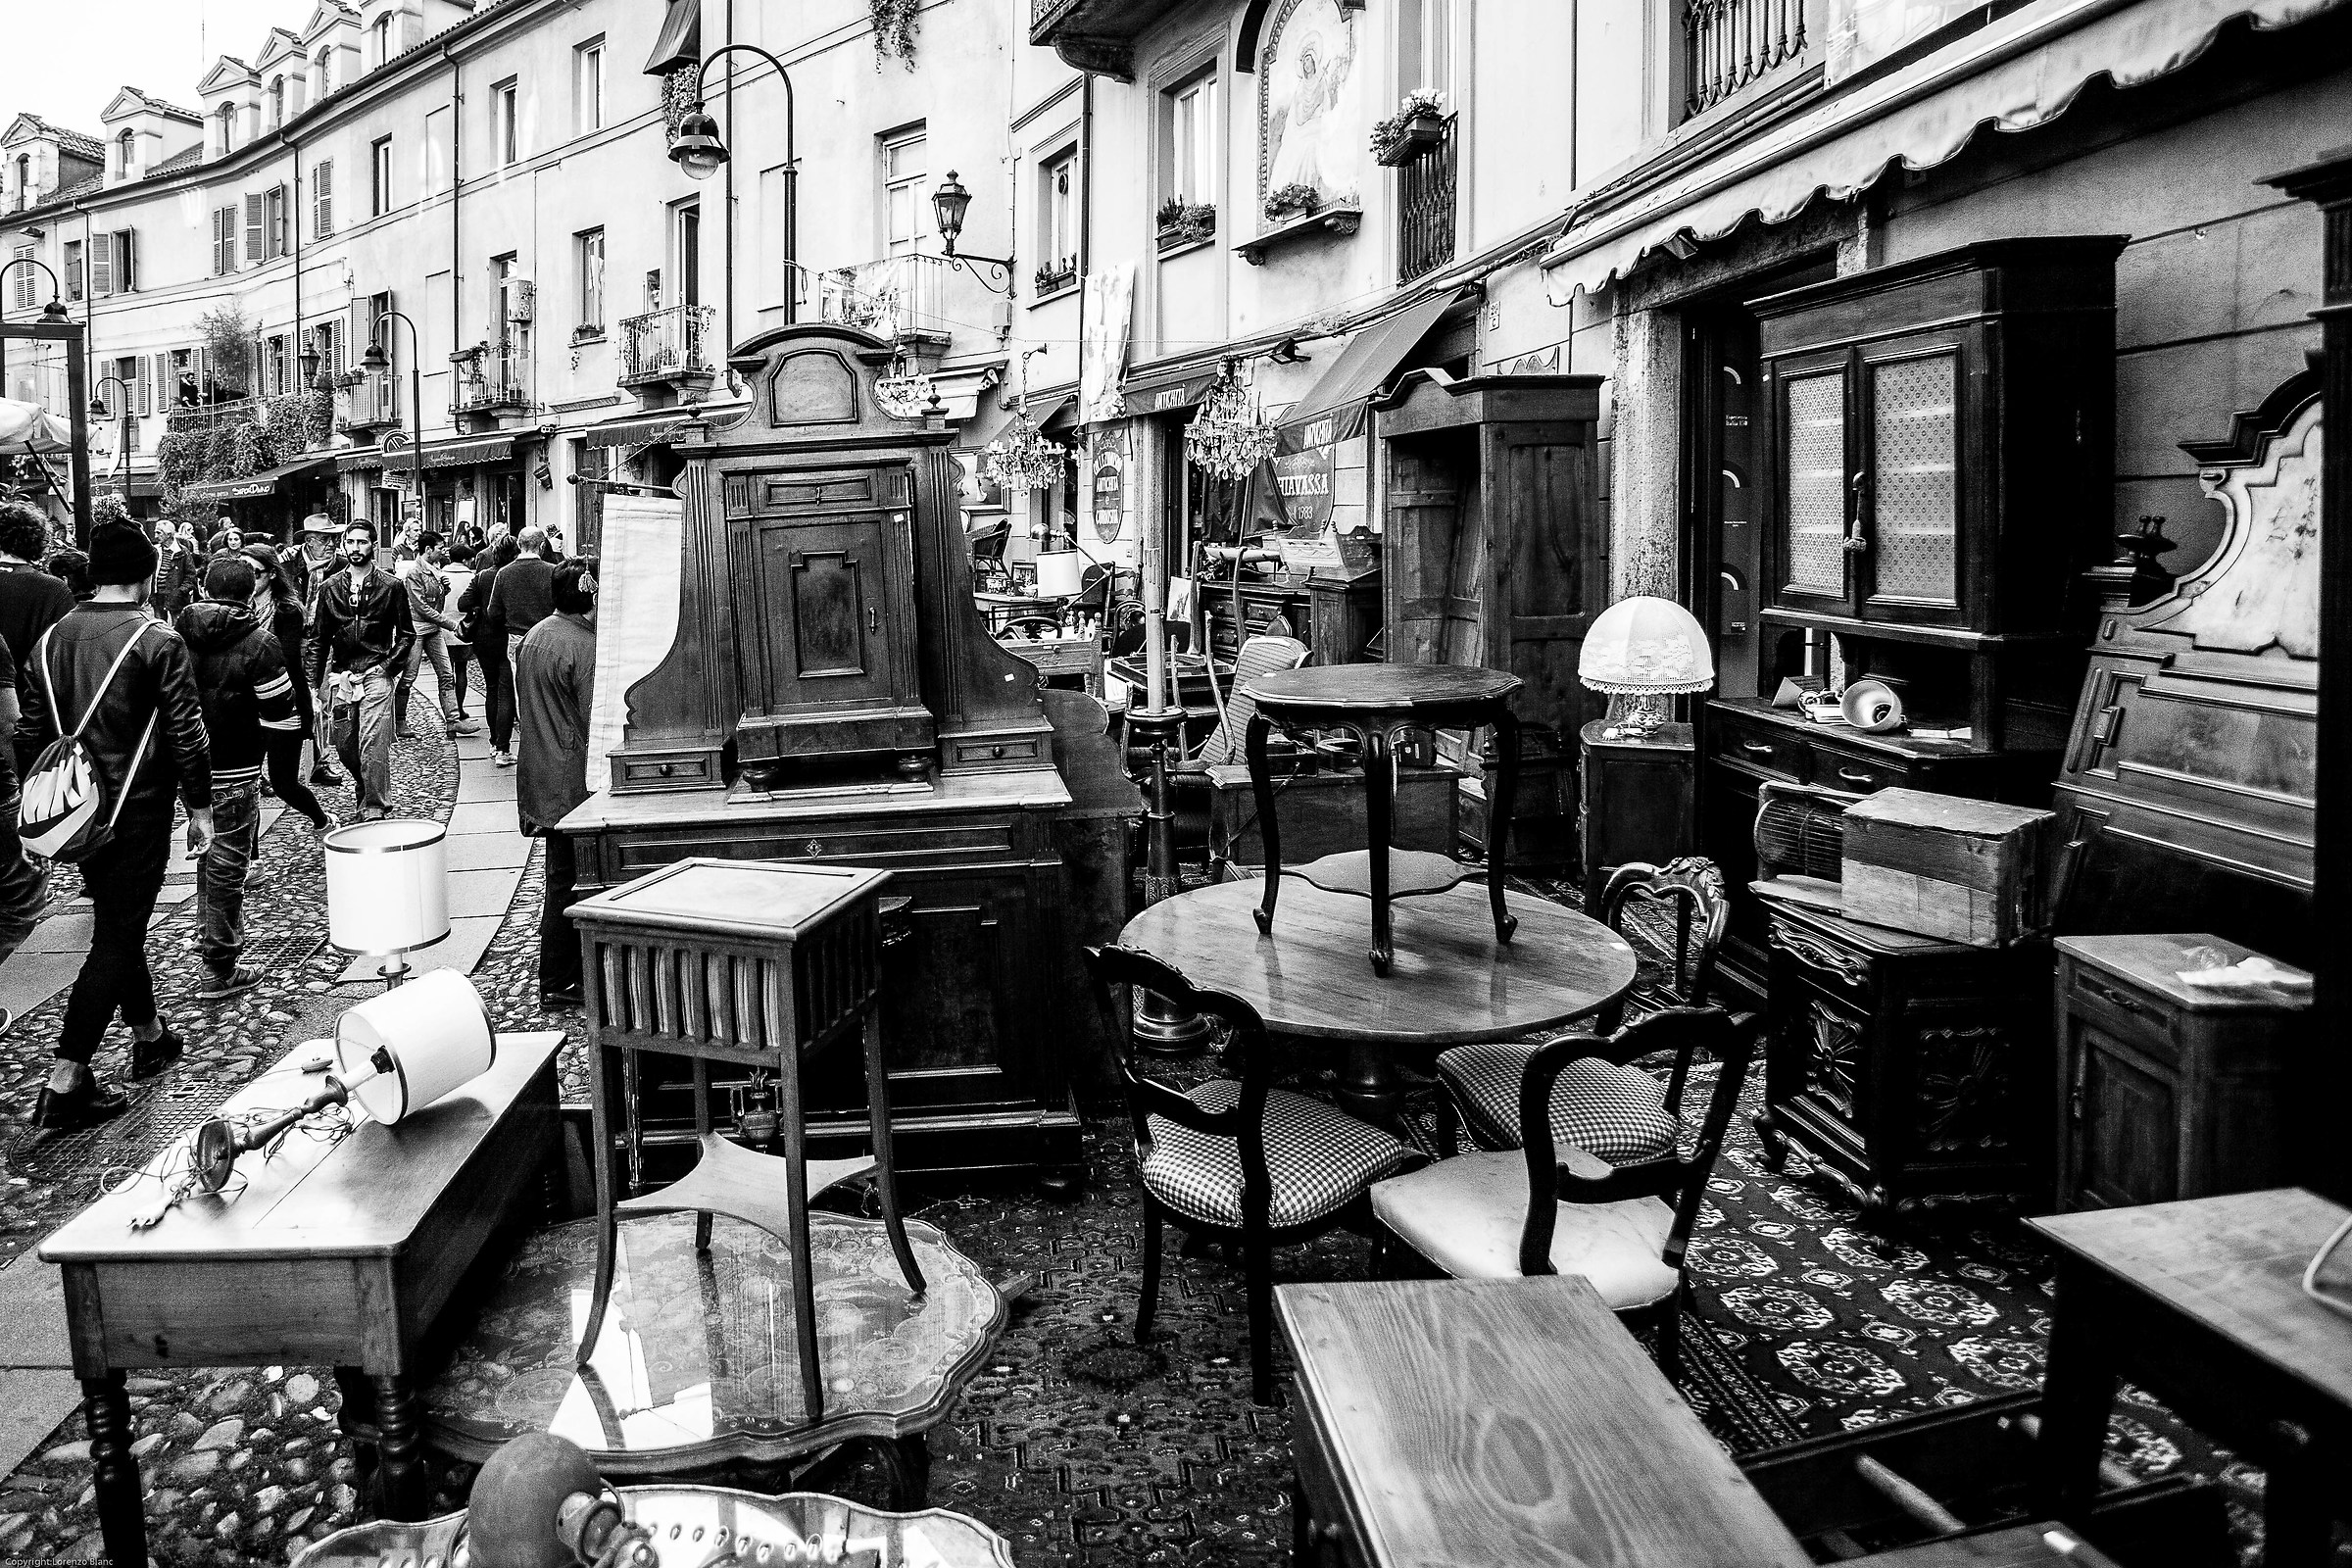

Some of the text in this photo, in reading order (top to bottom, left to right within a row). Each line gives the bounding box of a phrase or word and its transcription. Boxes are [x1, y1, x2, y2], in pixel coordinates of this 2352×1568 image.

[1154, 382, 1186, 412] ANTICHITÀ
[1277, 473, 1329, 496] HIAVASSA
[1298, 506, 1313, 519] 1983
